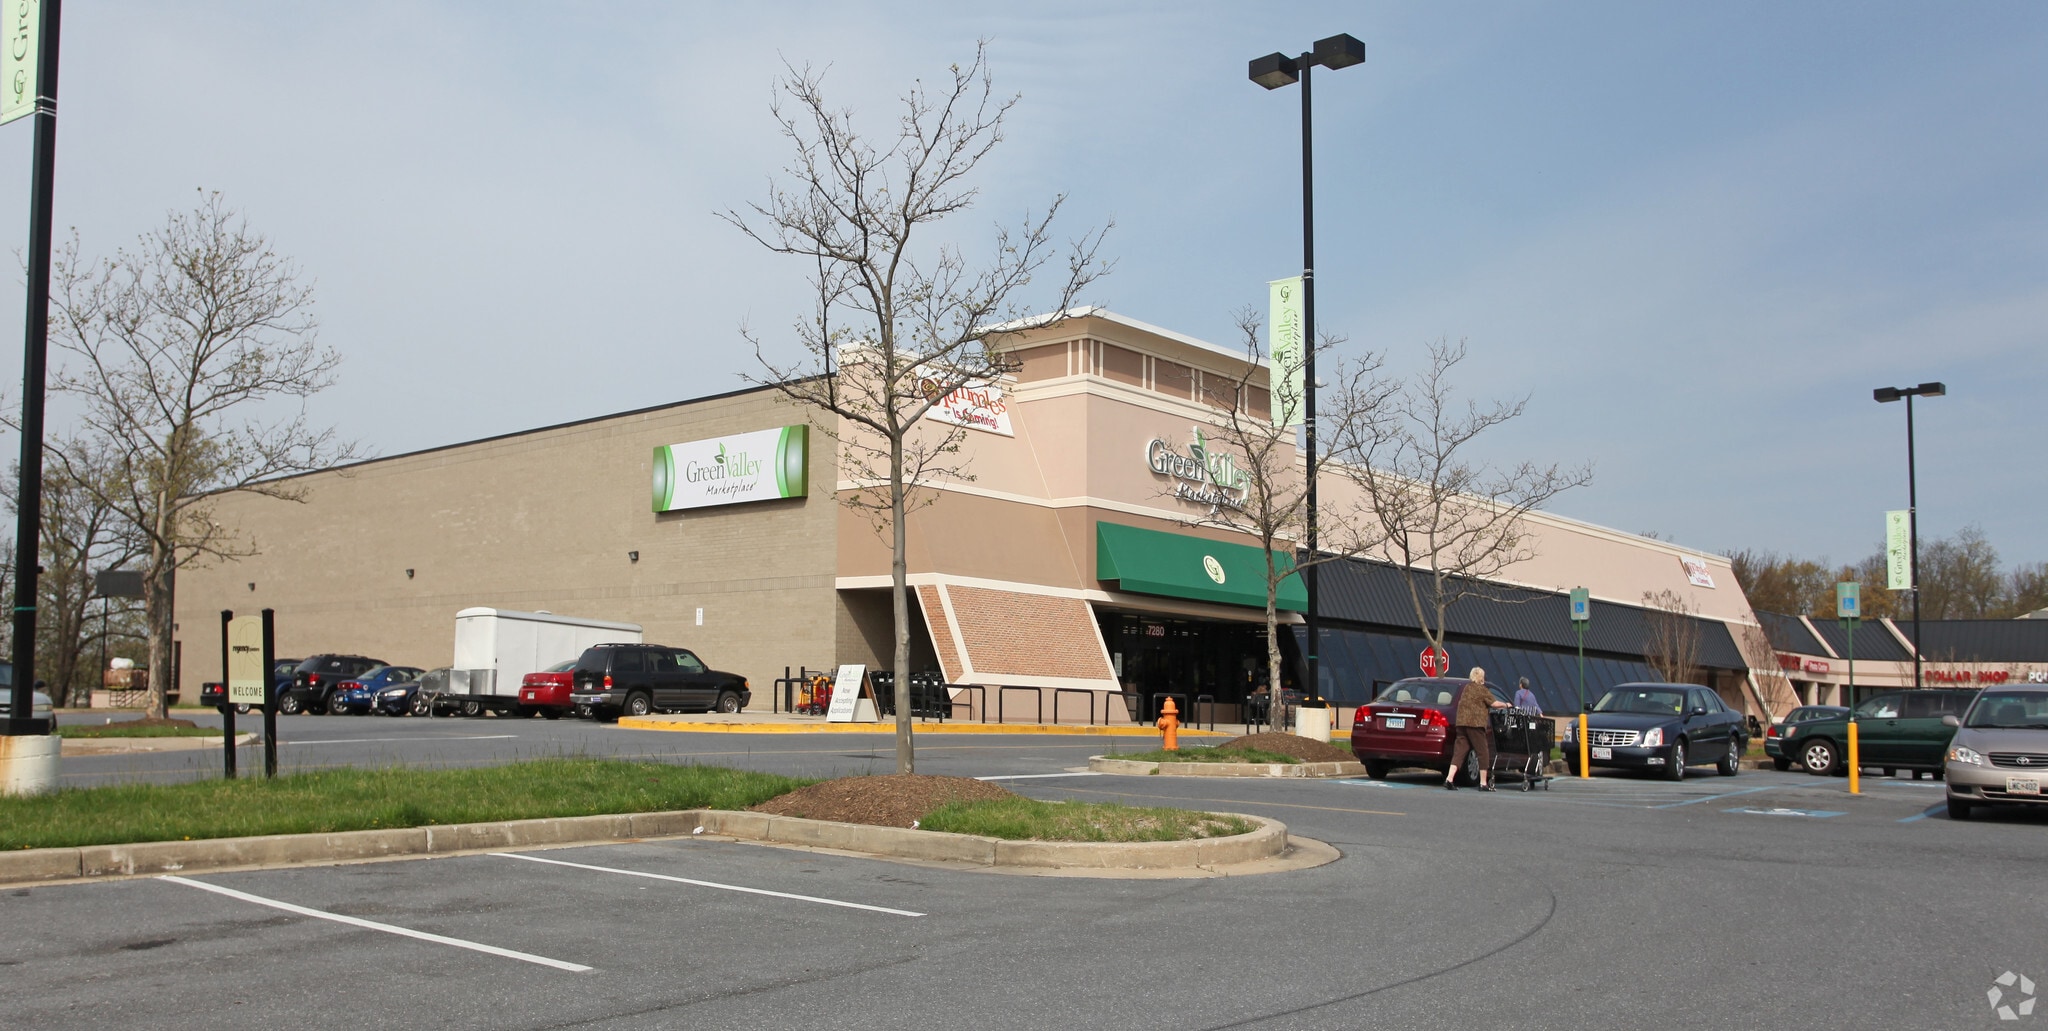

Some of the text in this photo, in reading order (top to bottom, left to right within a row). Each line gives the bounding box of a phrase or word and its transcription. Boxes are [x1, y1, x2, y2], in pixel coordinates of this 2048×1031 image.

[952, 407, 962, 419] Is
[706, 479, 755, 499] Marketplace
[1148, 625, 1165, 636] 7280
[1422, 655, 1446, 667] STP
[1925, 670, 1971, 682] DOLLAR
[1977, 671, 2009, 683] SHOP
[233, 687, 262, 697] WELCOME
